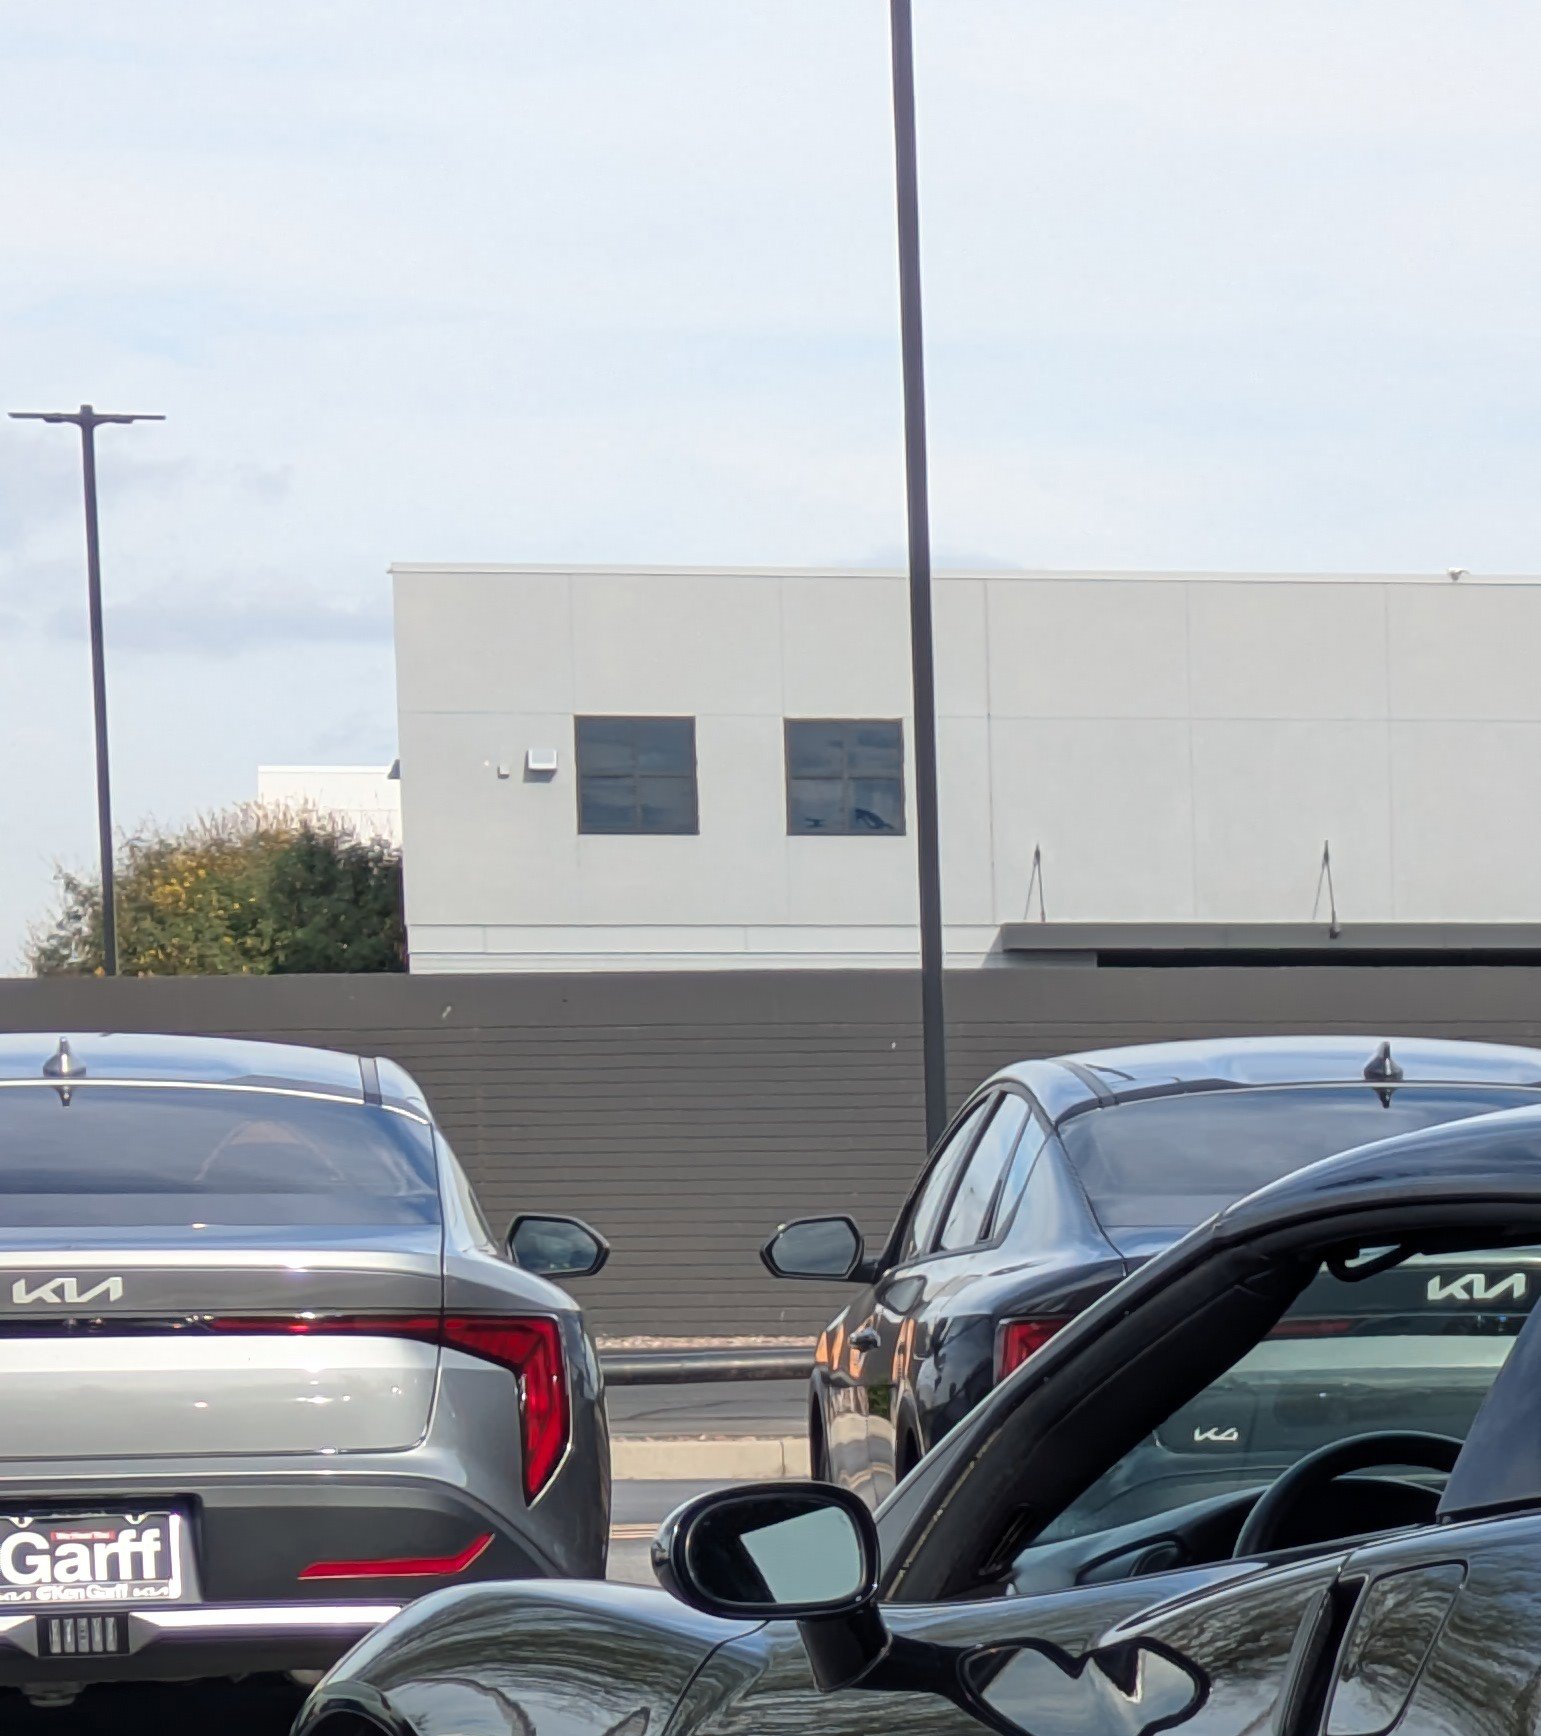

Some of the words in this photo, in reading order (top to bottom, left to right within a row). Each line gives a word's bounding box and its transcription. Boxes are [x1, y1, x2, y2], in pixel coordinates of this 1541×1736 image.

[12, 1276, 123, 1303] KIA
[1427, 1273, 1526, 1301] KIA
[0, 1528, 162, 1585] Garff
